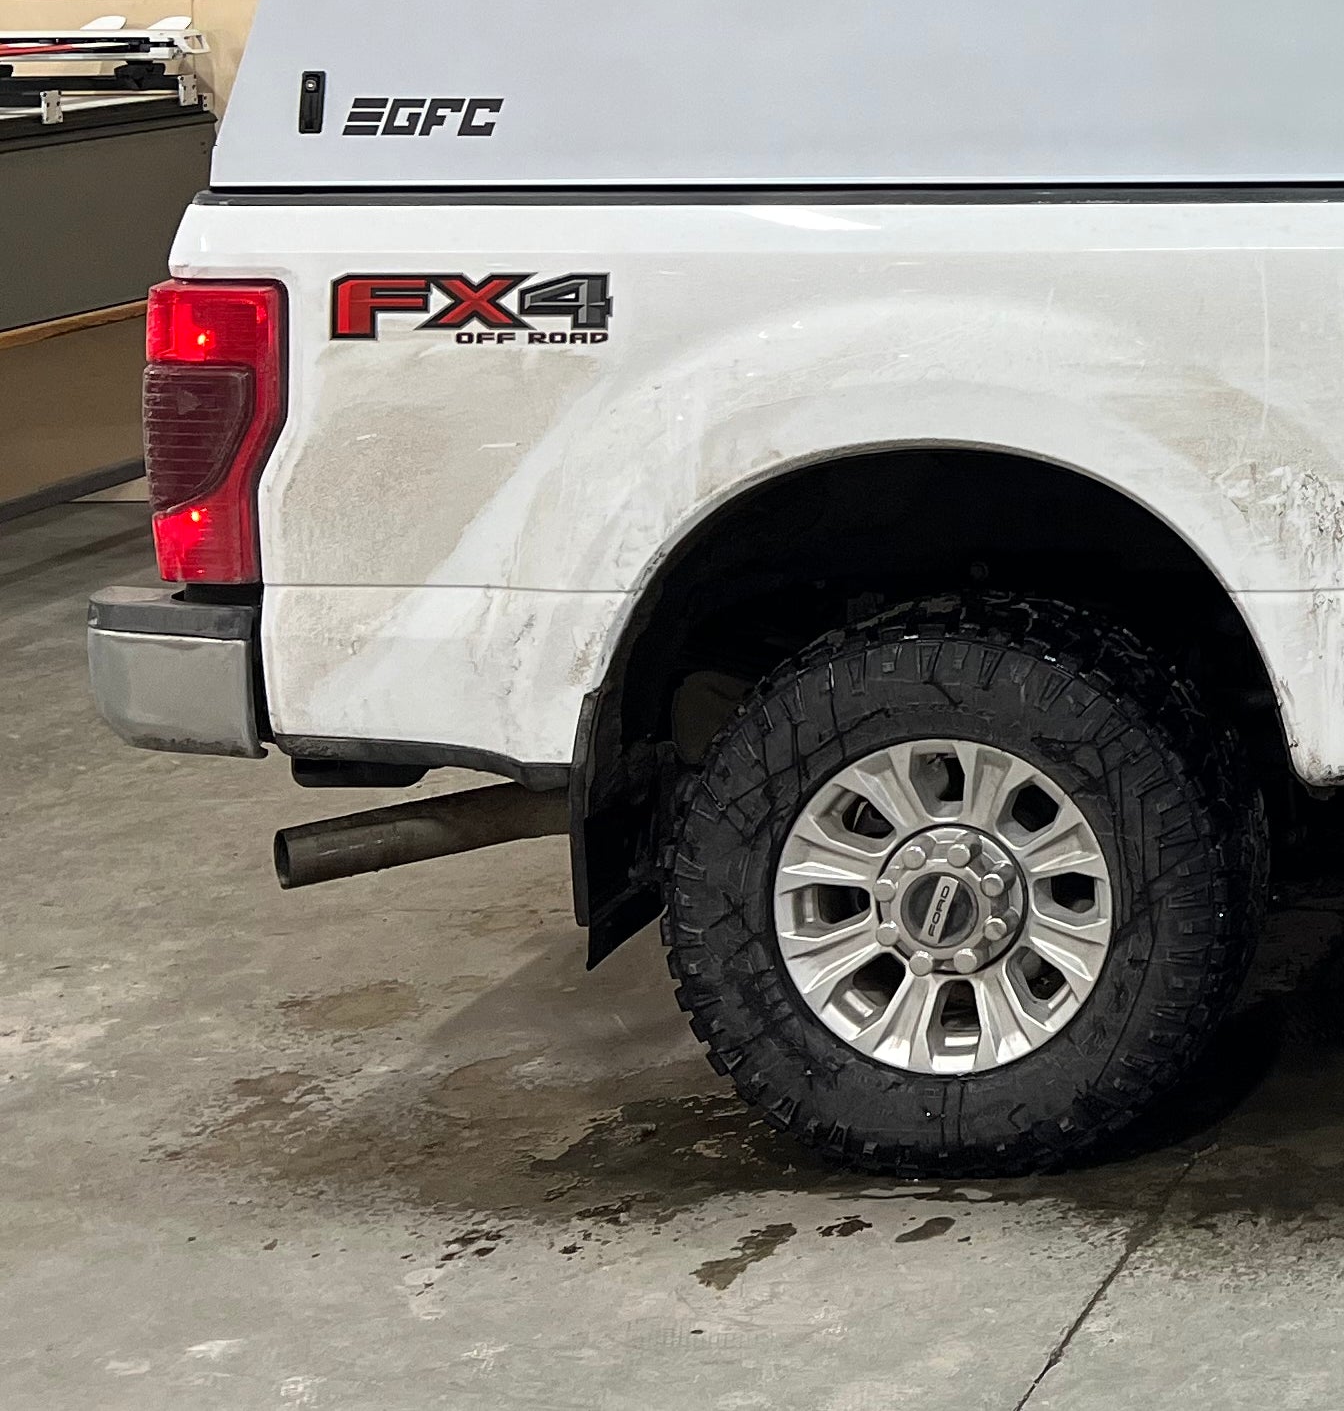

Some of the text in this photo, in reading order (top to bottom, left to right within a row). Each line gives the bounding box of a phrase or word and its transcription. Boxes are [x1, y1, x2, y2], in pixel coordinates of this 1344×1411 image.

[330, 271, 613, 341] FX4
[455, 332, 609, 344] OFF ROAD
[928, 885, 950, 937] FORD
